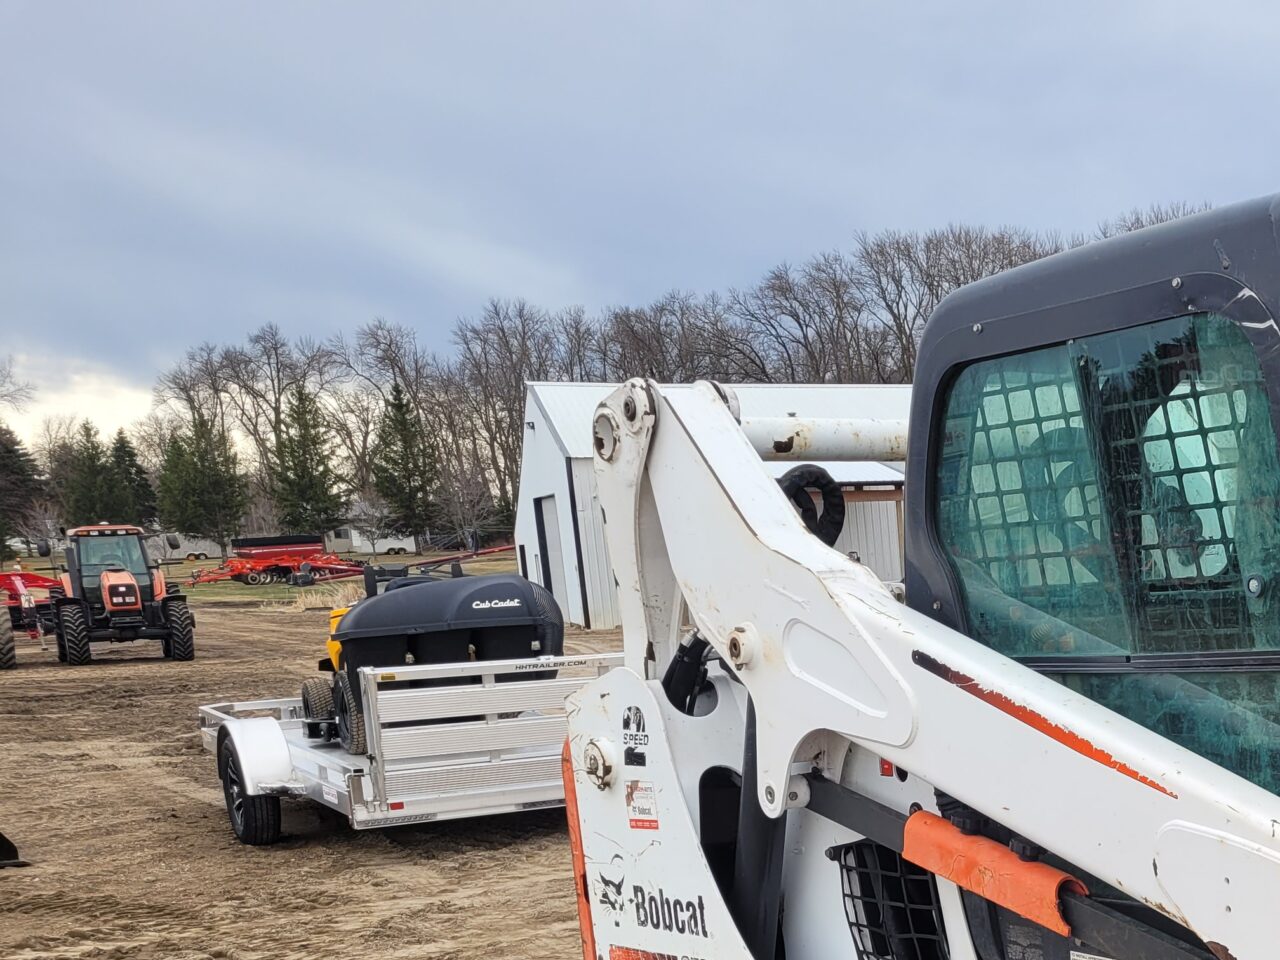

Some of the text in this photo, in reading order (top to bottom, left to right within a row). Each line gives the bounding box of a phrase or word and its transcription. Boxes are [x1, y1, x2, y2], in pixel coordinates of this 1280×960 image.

[472, 598, 521, 609] Cub Cadet
[515, 660, 587, 670] HHTRAILER.COM
[622, 733, 649, 745] SPEED
[632, 885, 708, 938] Bobcat
